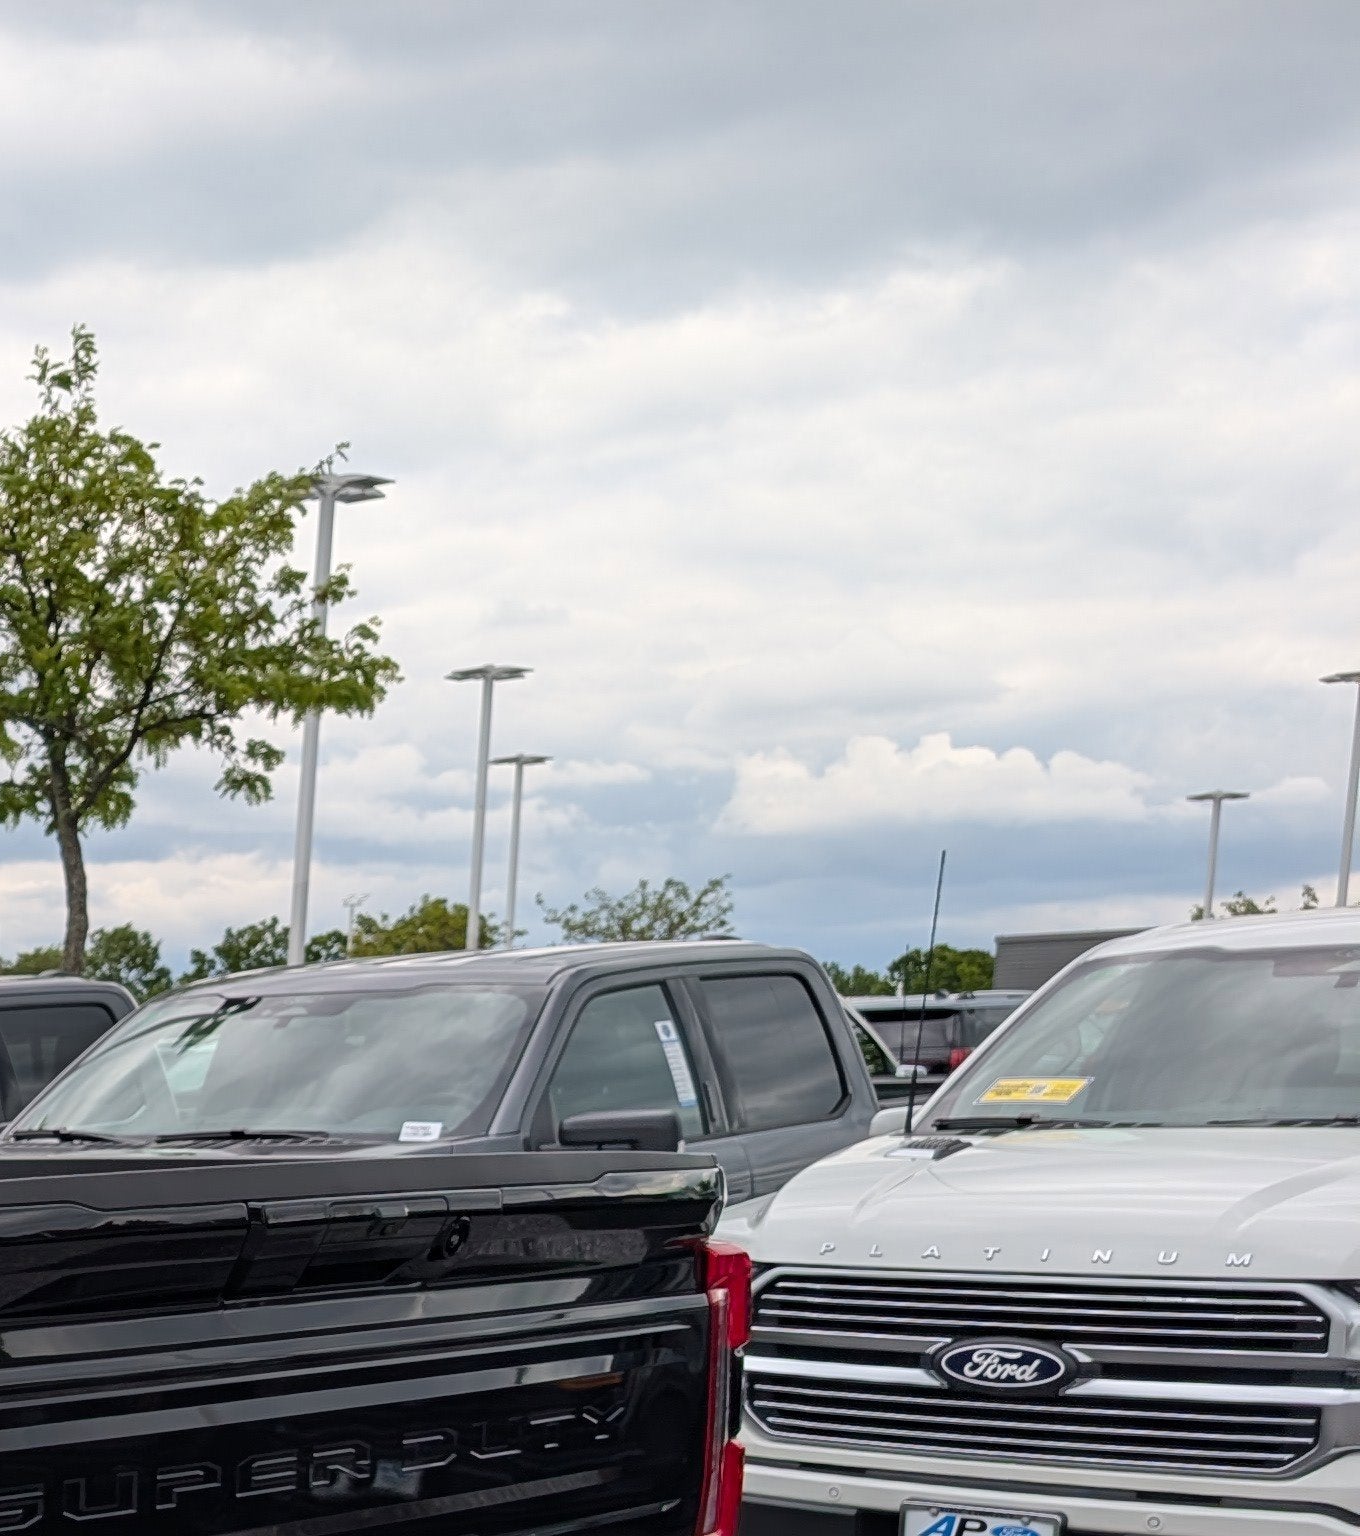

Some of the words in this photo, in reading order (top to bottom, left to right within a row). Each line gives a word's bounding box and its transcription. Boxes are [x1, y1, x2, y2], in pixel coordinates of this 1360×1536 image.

[819, 1241, 1254, 1268] PLATINUM
[963, 1348, 1040, 1382] Ford
[400, 1406, 626, 1472] DUTY
